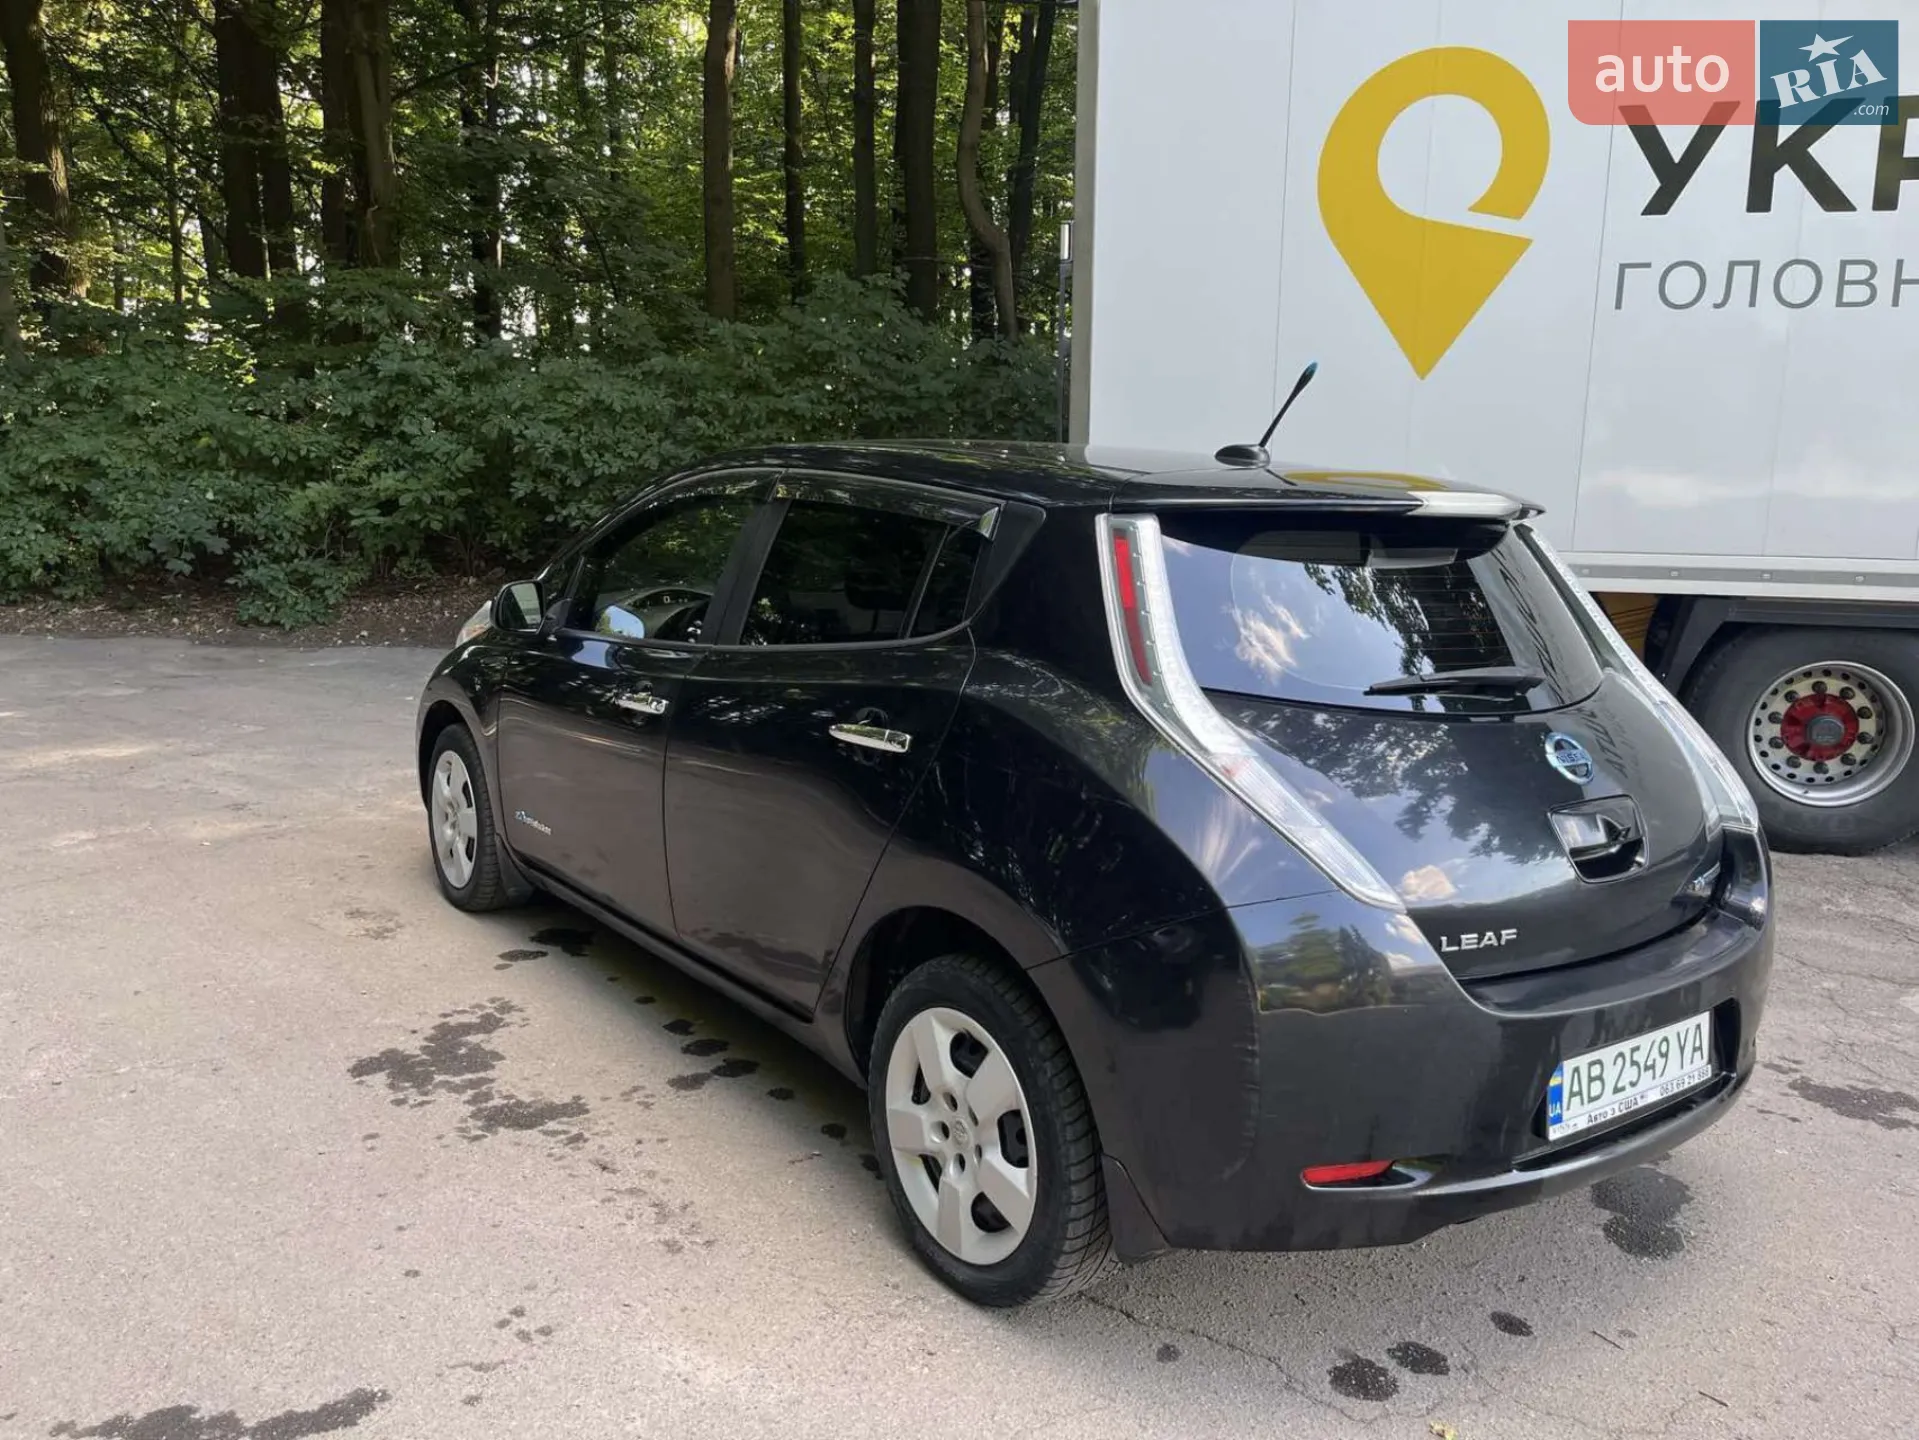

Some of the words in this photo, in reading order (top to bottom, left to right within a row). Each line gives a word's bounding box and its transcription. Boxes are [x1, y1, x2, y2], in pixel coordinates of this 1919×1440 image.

[1440, 928, 1517, 952] LEAF
[1566, 1058, 1606, 1111] AB
[1612, 1035, 1670, 1095] 2549
[1676, 1023, 1704, 1070] YA
[1618, 1097, 1639, 1113] США
